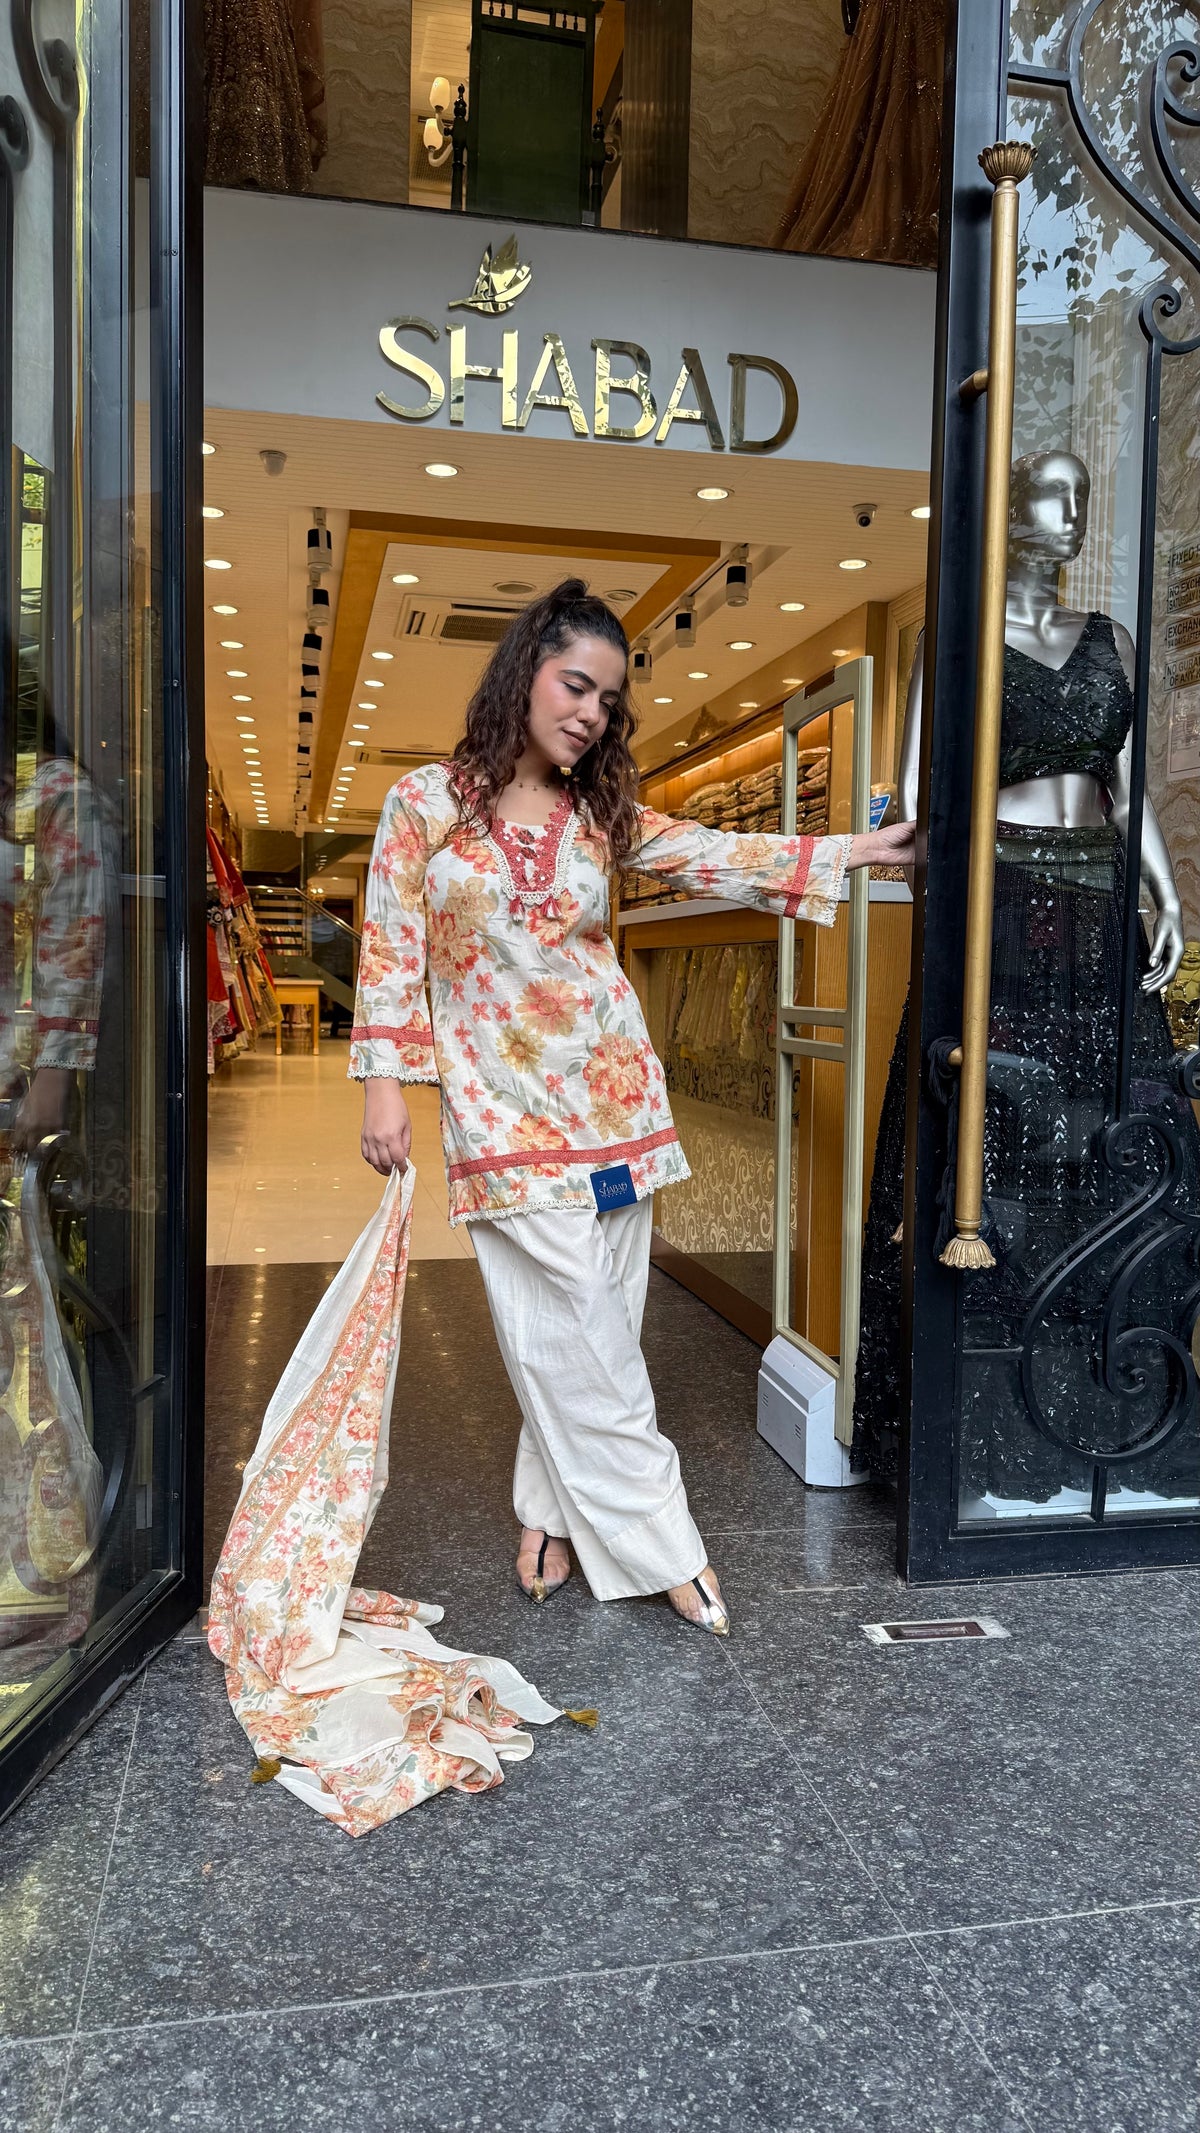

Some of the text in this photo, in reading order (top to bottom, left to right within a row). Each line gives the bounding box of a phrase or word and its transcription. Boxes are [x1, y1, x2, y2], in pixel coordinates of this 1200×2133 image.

[376, 315, 799, 452] SHABAD
[1171, 546, 1195, 568] FIXED
[1168, 616, 1200, 639] EXCHAN
[1167, 664, 1176, 676] NO
[1170, 674, 1178, 686] OF
